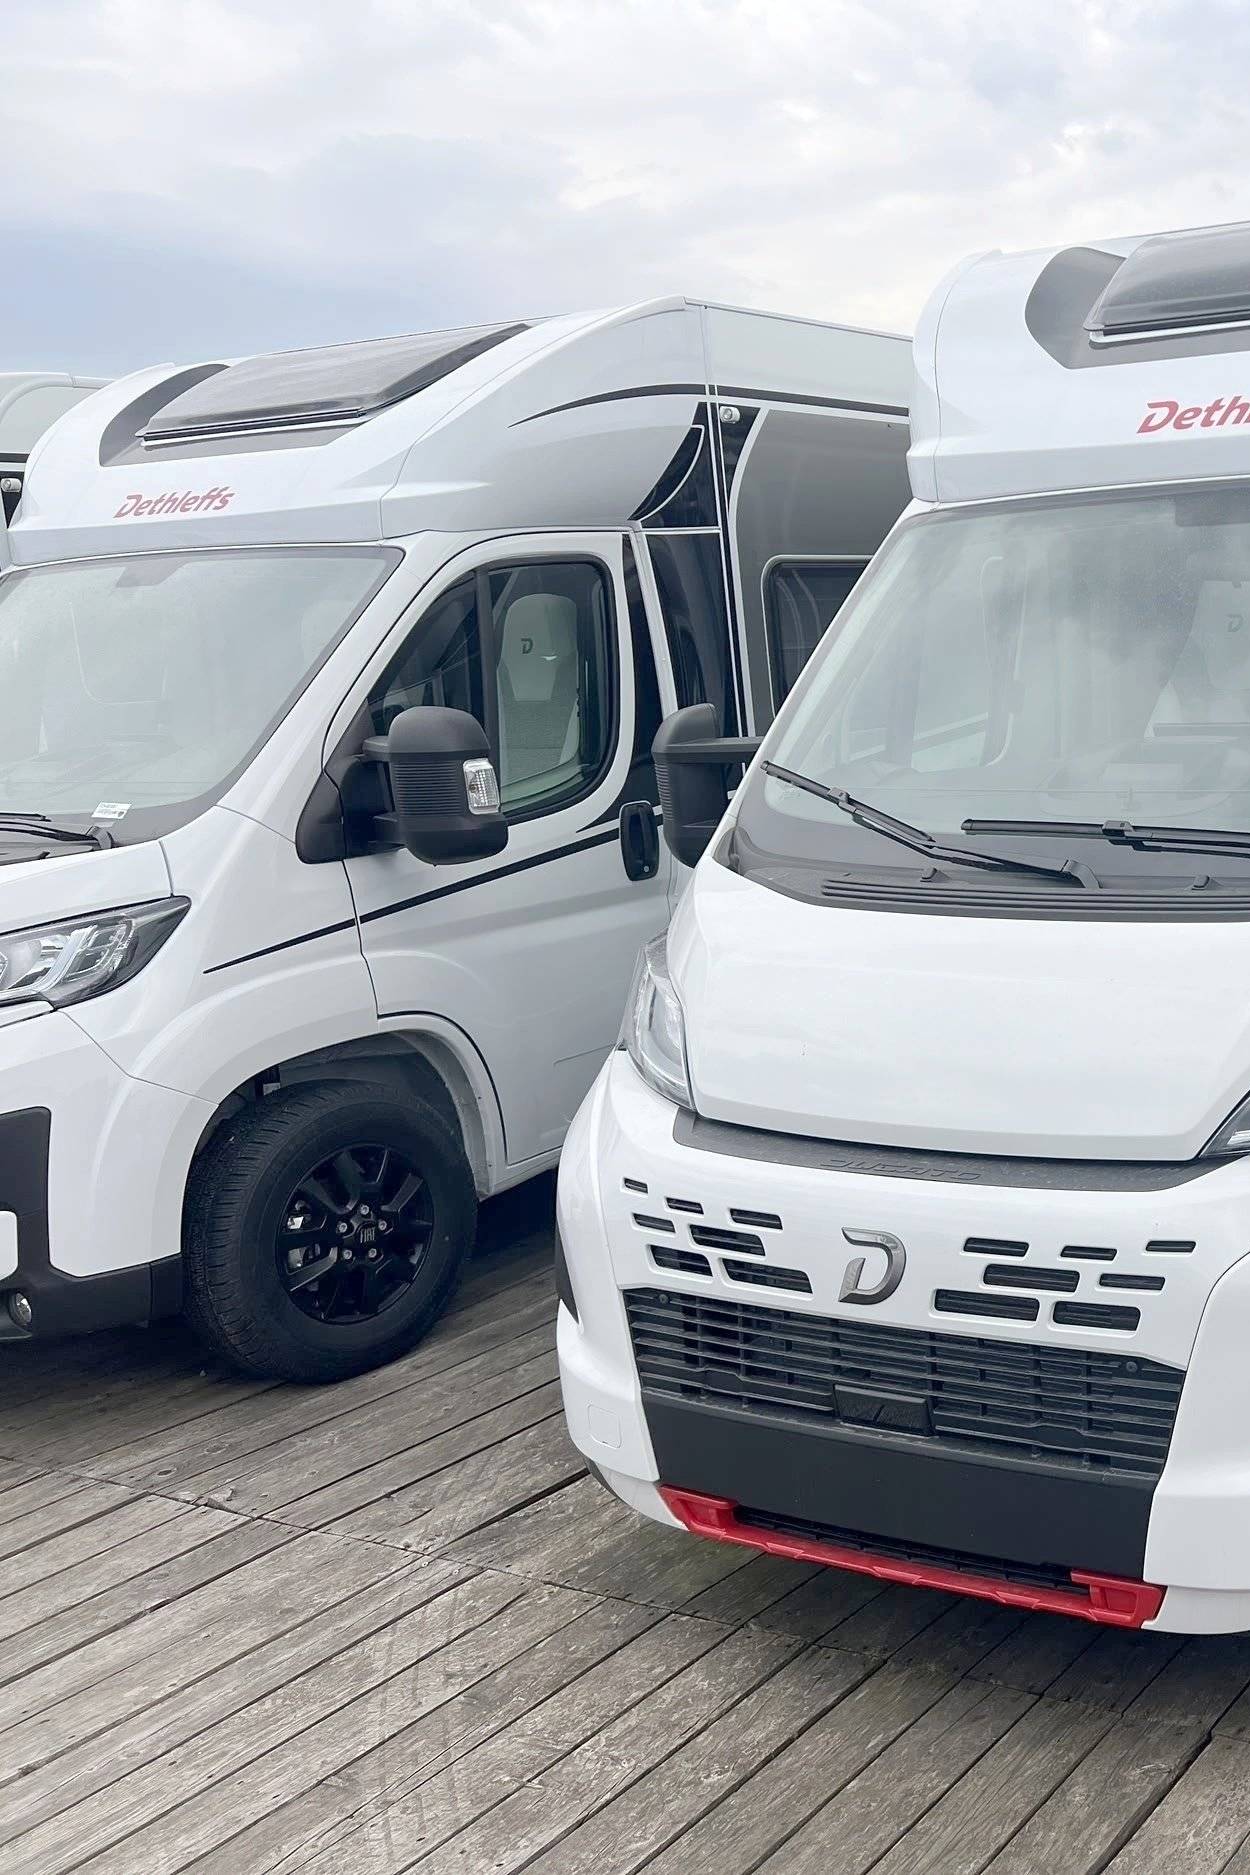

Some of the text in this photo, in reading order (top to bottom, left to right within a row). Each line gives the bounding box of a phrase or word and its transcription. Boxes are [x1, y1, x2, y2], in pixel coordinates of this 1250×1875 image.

[112, 486, 236, 519] Dethleffs
[820, 1159, 981, 1181] DUCATO
[360, 1226, 376, 1244] FIAT
[838, 1226, 907, 1305] D
